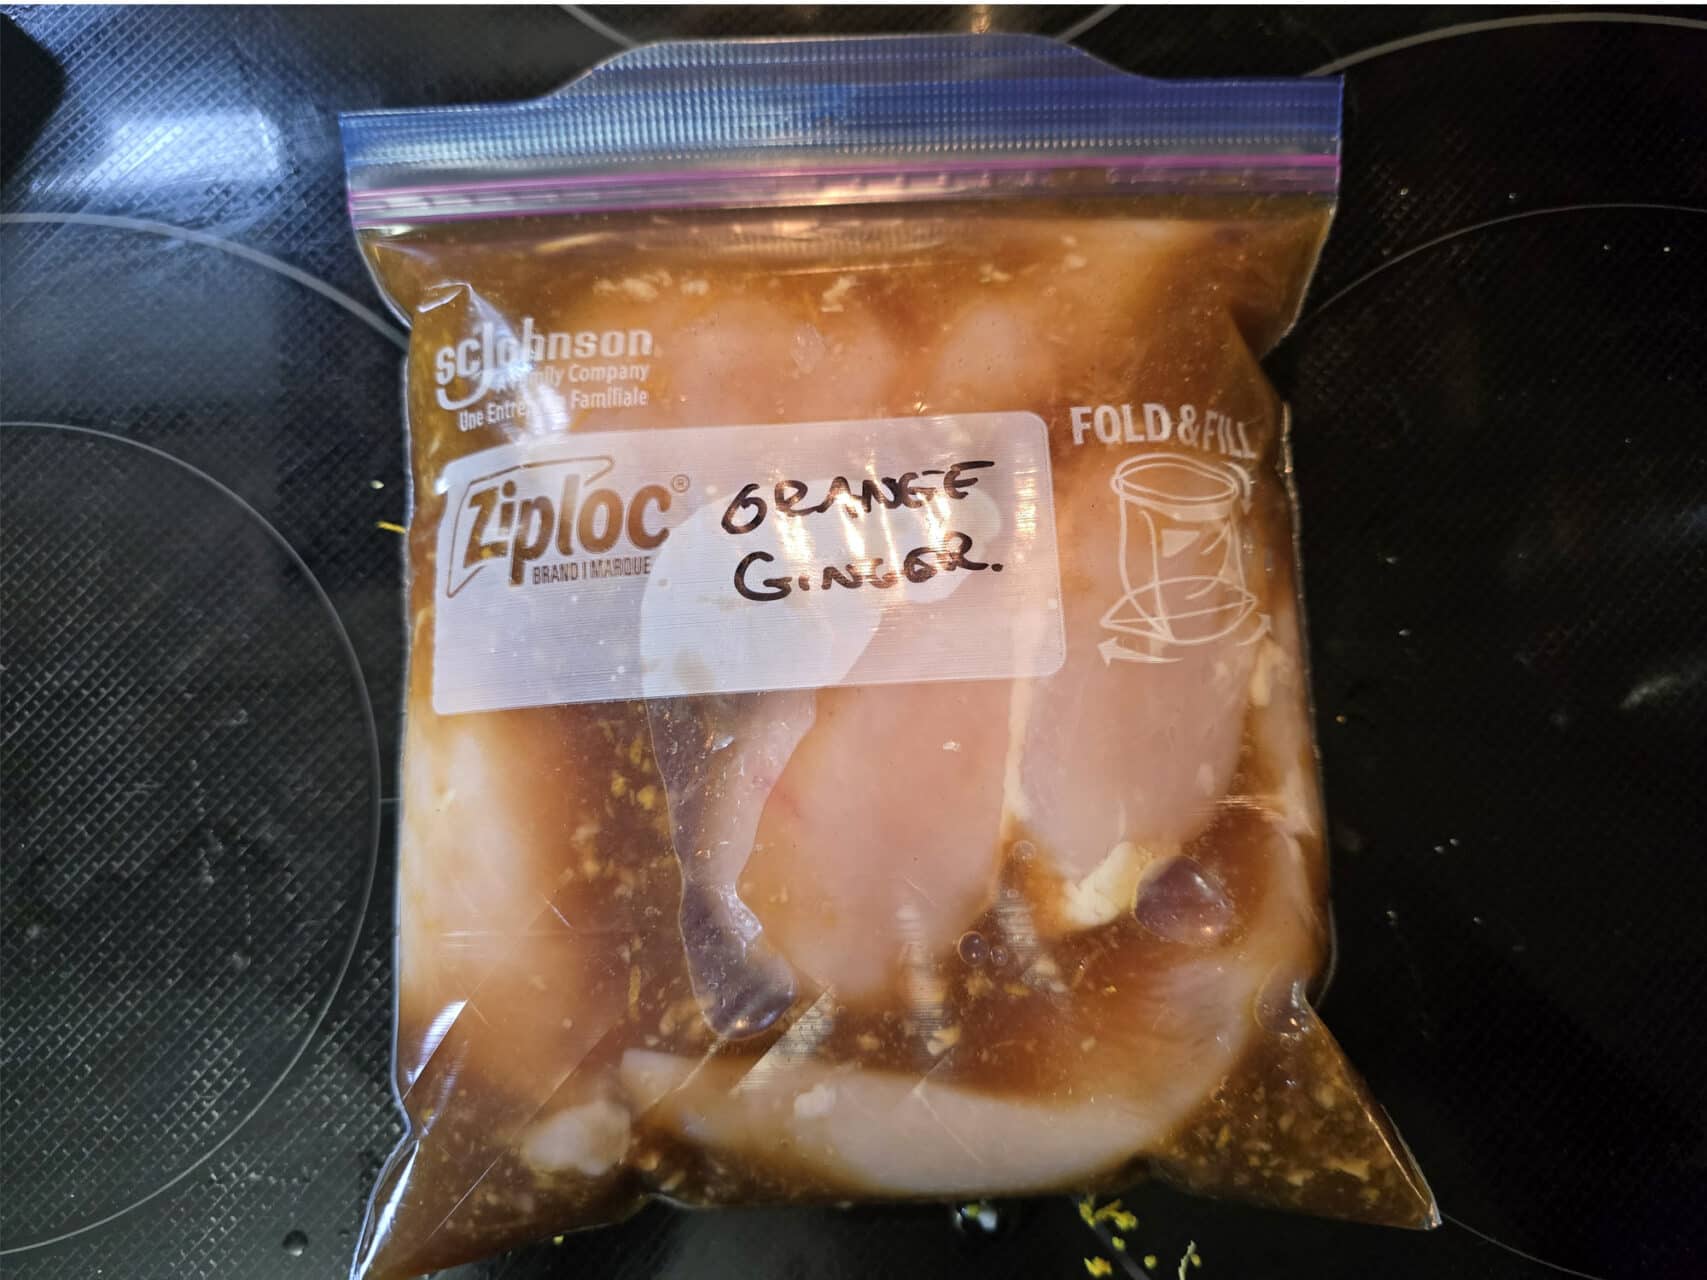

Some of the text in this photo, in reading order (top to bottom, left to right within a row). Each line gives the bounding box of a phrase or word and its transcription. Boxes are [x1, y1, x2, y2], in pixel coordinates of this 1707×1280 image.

[569, 363, 649, 384] Company
[459, 410, 485, 432] Une
[571, 385, 649, 409] Familiale
[1070, 403, 1171, 445] FOLD
[721, 460, 995, 535] ORANGE
[533, 562, 578, 584] BRAND
[589, 556, 651, 578] MARQUE
